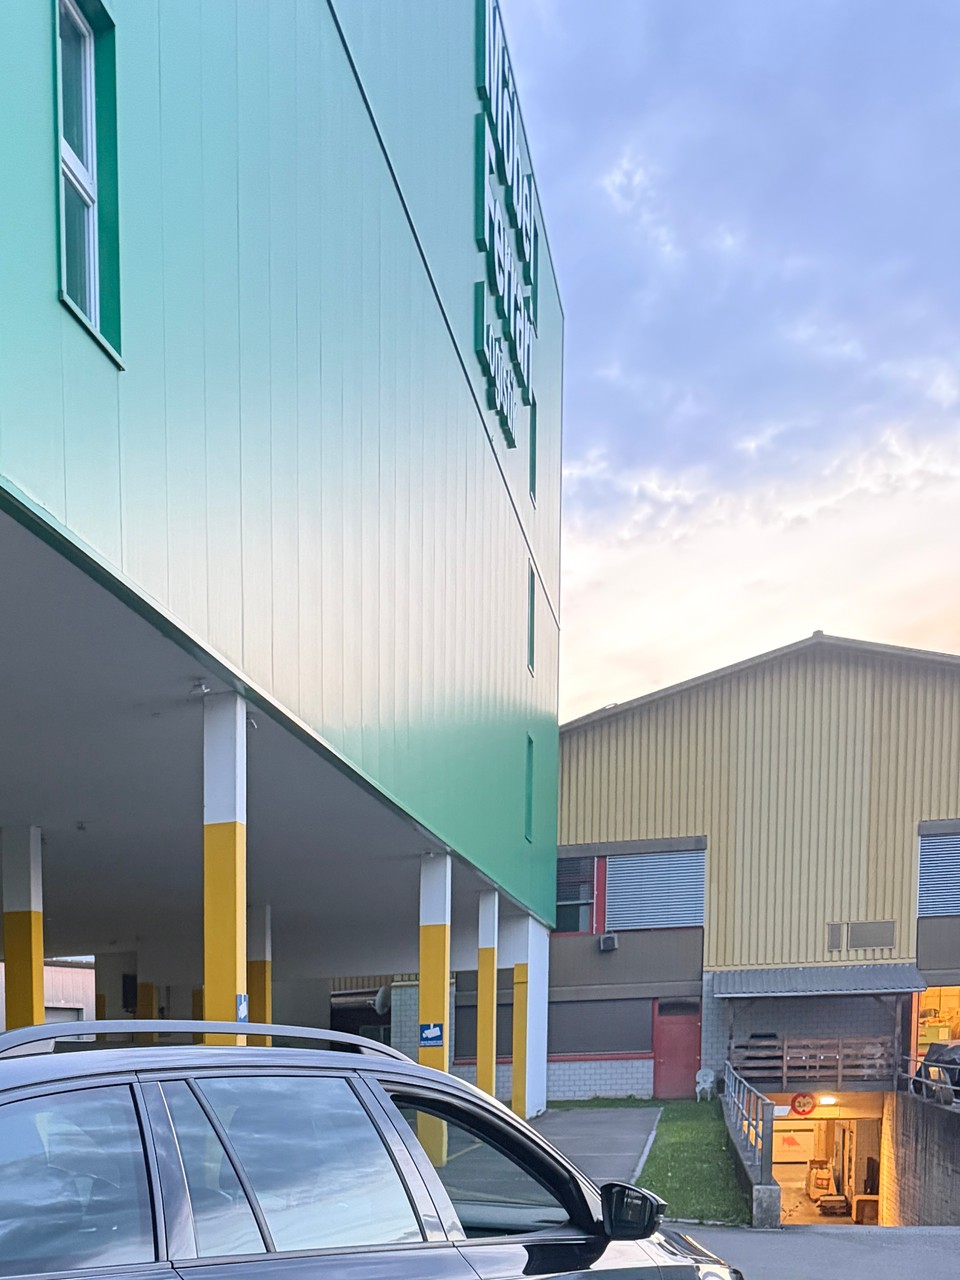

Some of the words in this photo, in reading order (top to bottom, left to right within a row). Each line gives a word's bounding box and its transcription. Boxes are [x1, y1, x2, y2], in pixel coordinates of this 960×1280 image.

[483, 0, 535, 286] Möbel
[483, 112, 533, 406] Ferrari
[482, 281, 517, 447] Logistik
